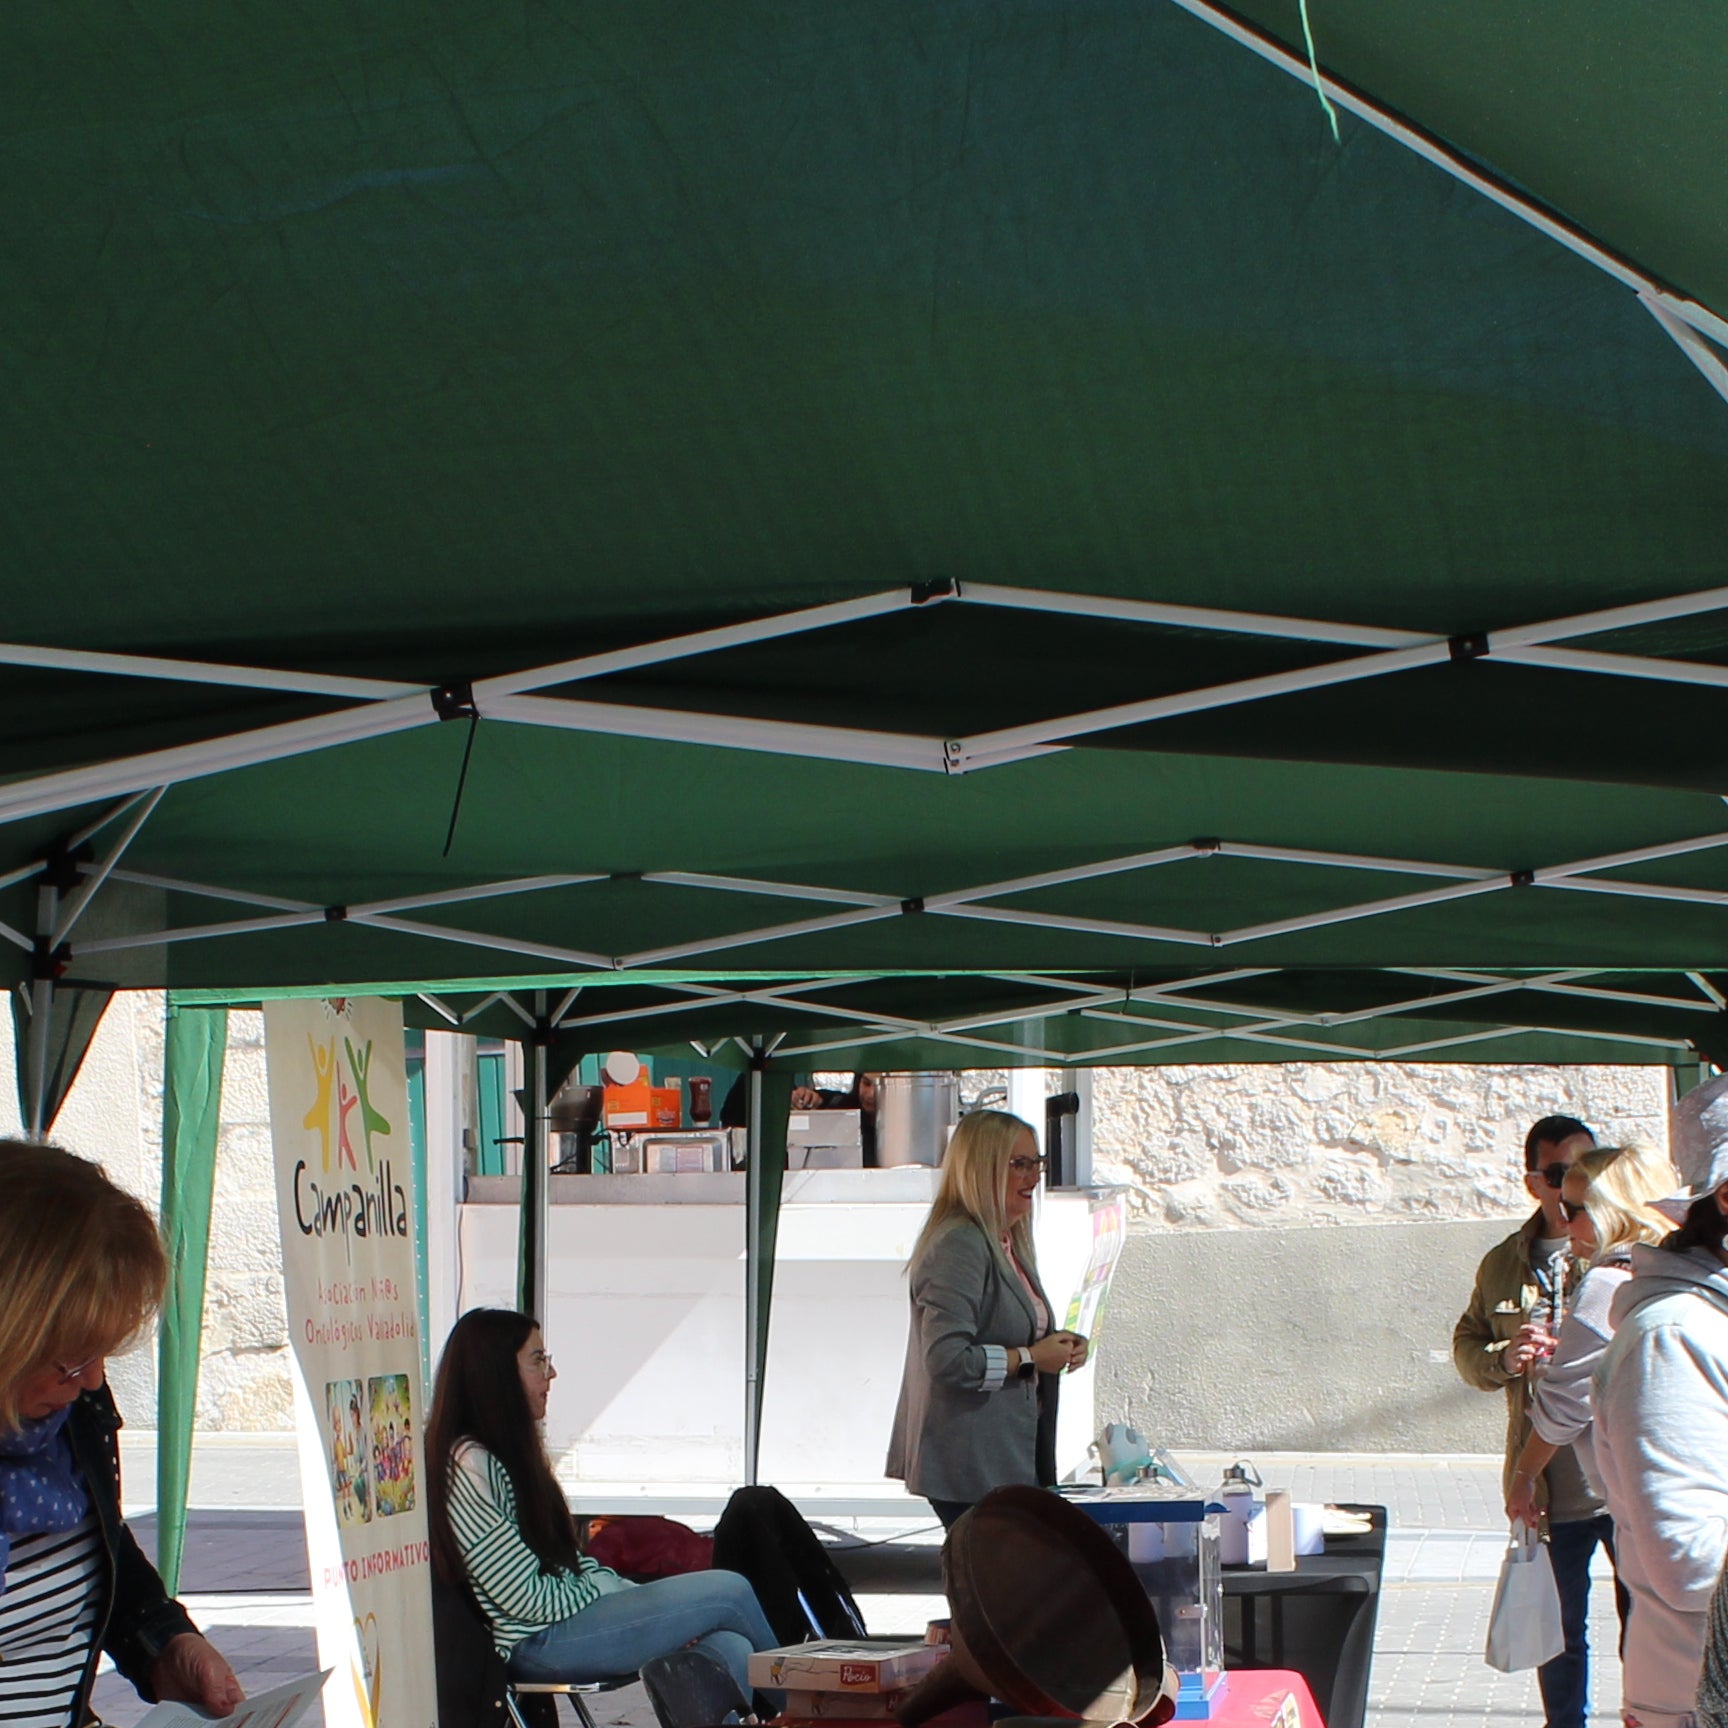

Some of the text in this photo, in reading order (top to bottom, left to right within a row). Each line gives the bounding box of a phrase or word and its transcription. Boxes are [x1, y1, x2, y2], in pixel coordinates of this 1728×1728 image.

[294, 1159, 407, 1267] Campanilla
[323, 1540, 429, 1589] PUNTO INFORMATIVO
